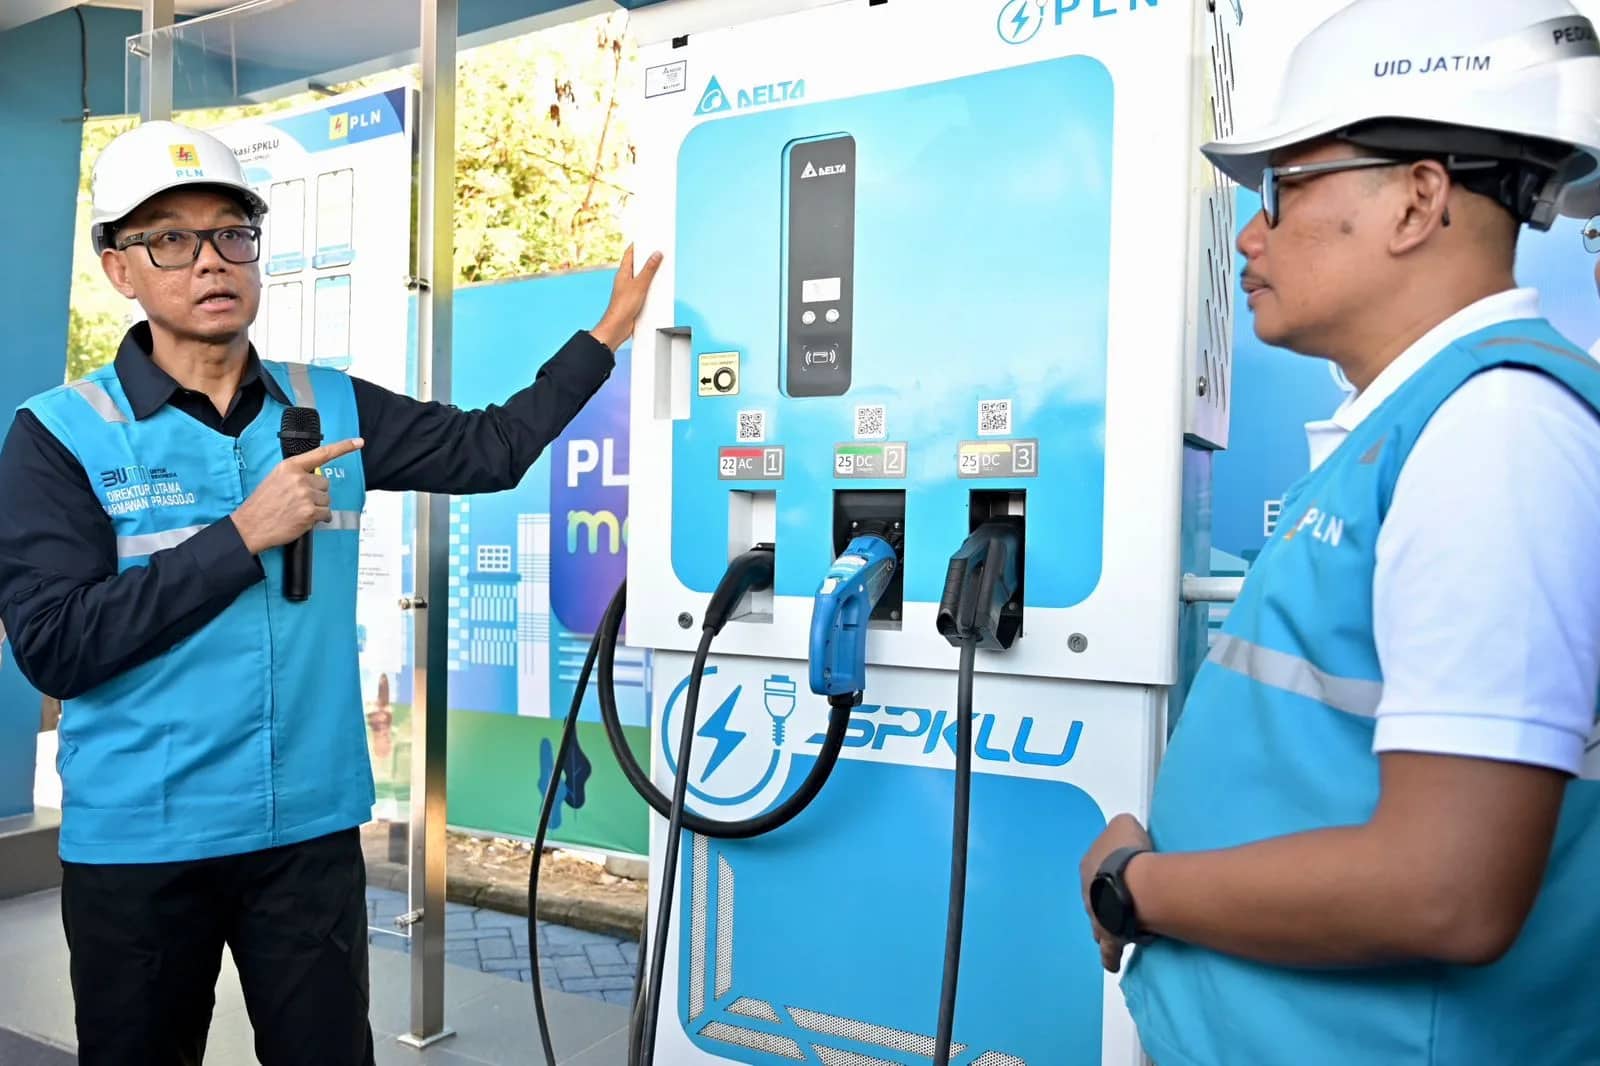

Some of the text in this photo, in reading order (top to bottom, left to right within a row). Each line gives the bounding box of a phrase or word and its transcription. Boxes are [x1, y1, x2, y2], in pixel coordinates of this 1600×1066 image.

[1373, 55, 1491, 77] UID JATIM
[737, 78, 805, 108] DELTA
[350, 109, 381, 129] PLN
[175, 168, 204, 177] PLN
[722, 453, 777, 471] 22 AC 1
[838, 450, 899, 469] 25 DC 2
[961, 448, 1030, 468] 25 DC 3
[324, 467, 345, 479] PLN
[106, 481, 182, 503] DIREKTUR UTAMA
[567, 510, 628, 555] m
[1297, 507, 1344, 547] PLN
[806, 704, 1084, 767] SPKLU
